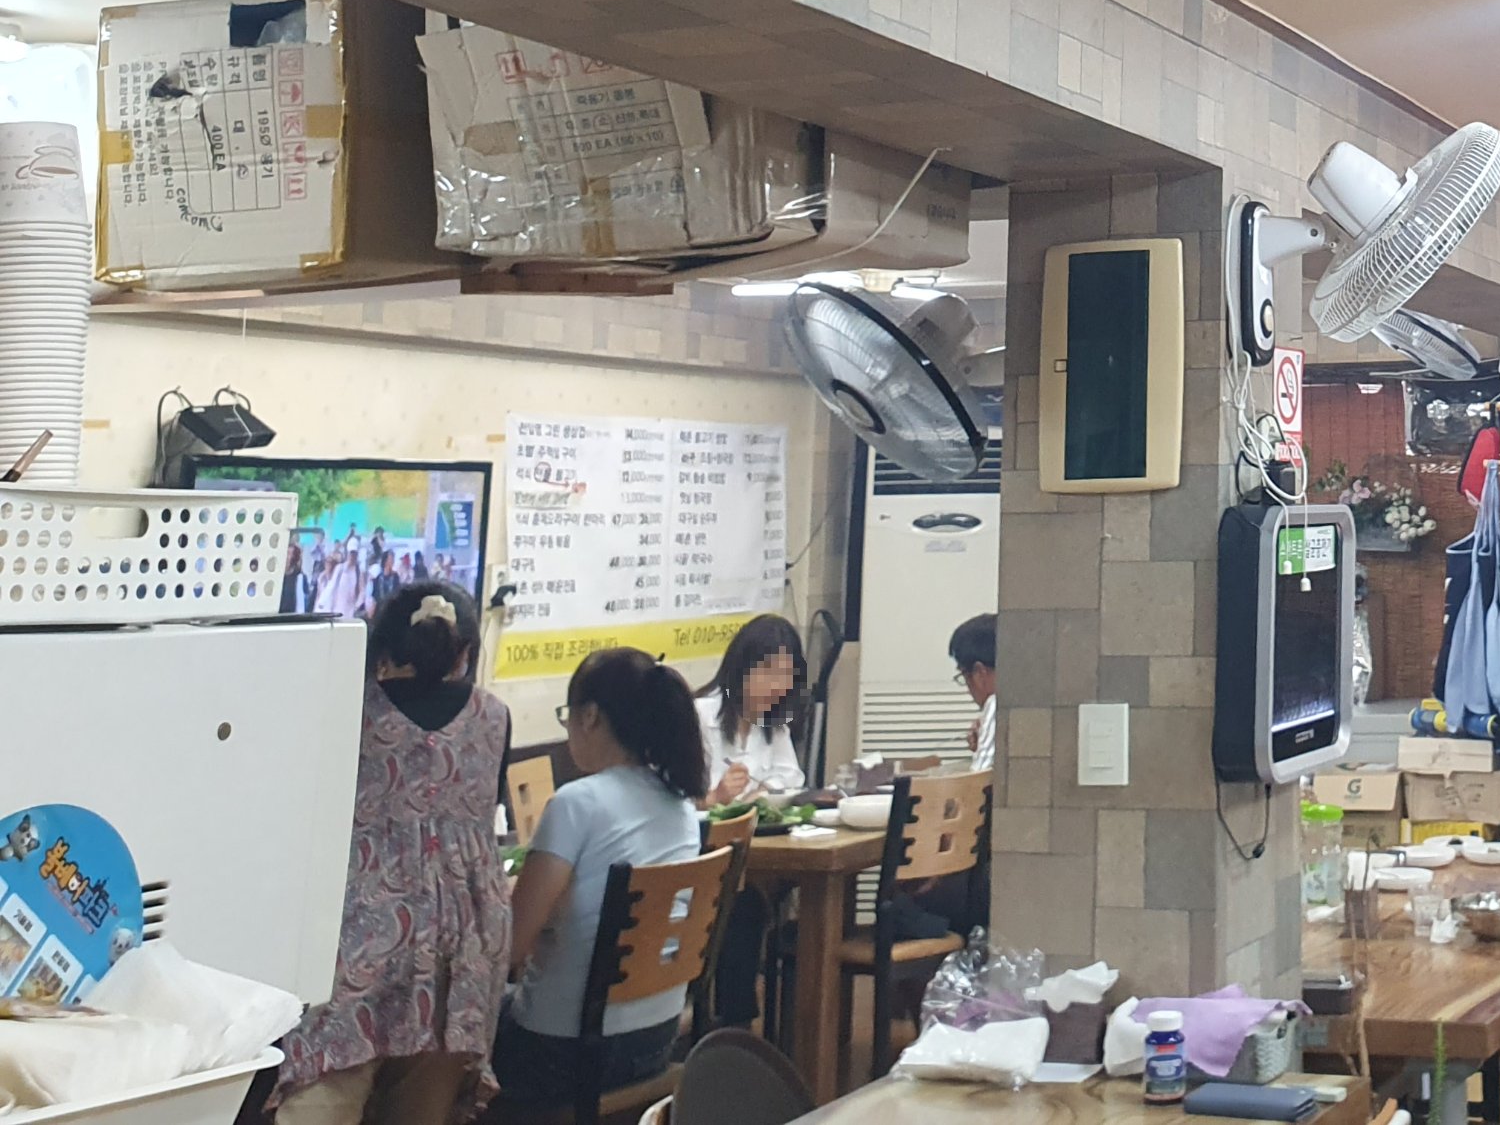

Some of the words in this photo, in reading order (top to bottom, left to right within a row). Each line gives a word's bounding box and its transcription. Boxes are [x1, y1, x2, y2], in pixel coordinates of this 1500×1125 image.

[227, 56, 242, 85] 규격
[674, 628, 691, 646] Tel
[506, 642, 539, 663] 100%
[543, 641, 564, 661] 직접
